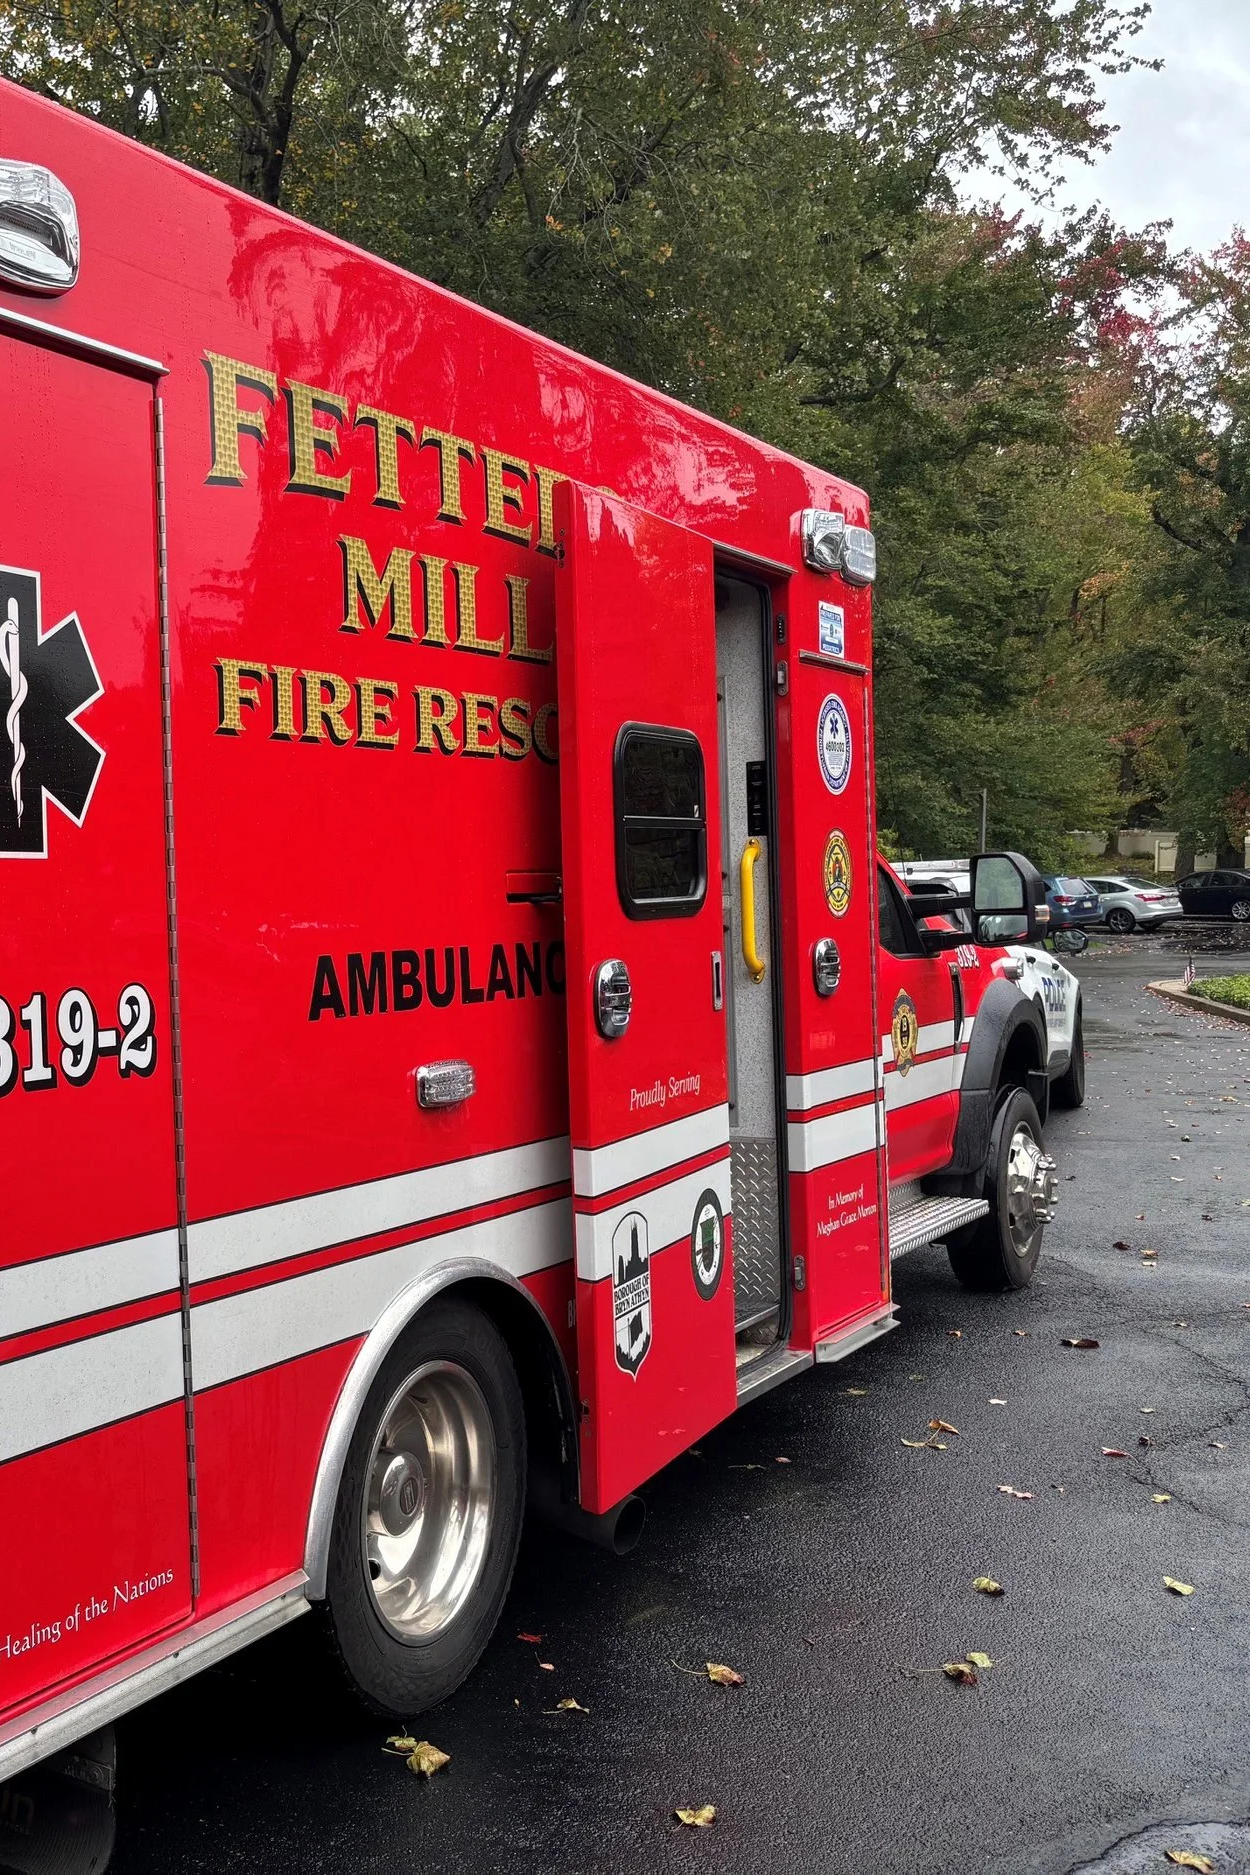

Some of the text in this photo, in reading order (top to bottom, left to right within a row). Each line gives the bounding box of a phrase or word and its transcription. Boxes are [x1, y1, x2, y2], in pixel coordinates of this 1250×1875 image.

[200, 348, 621, 560] FETTE
[335, 534, 553, 667] MILL
[213, 656, 401, 751] FIRE
[630, 1071, 701, 1111] Proudly Serving
[828, 1195, 835, 1210] In
[834, 1191, 858, 1208] Memory
[614, 1273, 649, 1304] BOROUGH OF
[615, 1286, 649, 1316] BRYN ATHYN
[65, 1605, 83, 1634] of
[85, 1595, 109, 1622] the
[112, 1568, 174, 1612] Nations
